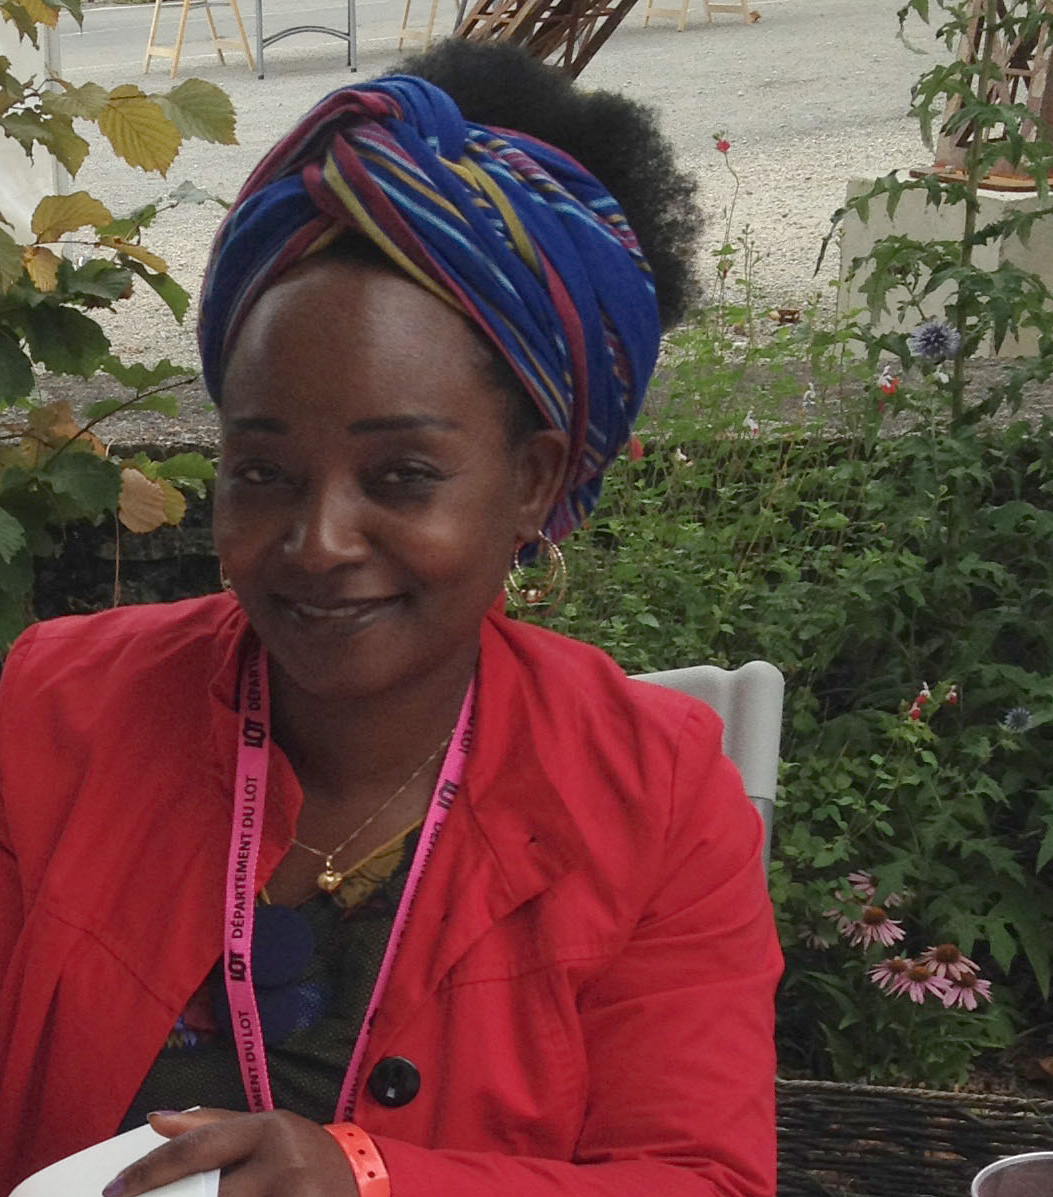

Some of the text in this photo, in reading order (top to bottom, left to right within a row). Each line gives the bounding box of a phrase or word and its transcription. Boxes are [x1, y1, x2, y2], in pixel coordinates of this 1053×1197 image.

[244, 775, 258, 802] LOT
[242, 806, 255, 829] DU
[231, 833, 253, 939] DÉPARTEMENT
[238, 1010, 251, 1037] LOT
[245, 1039, 255, 1062] DU
